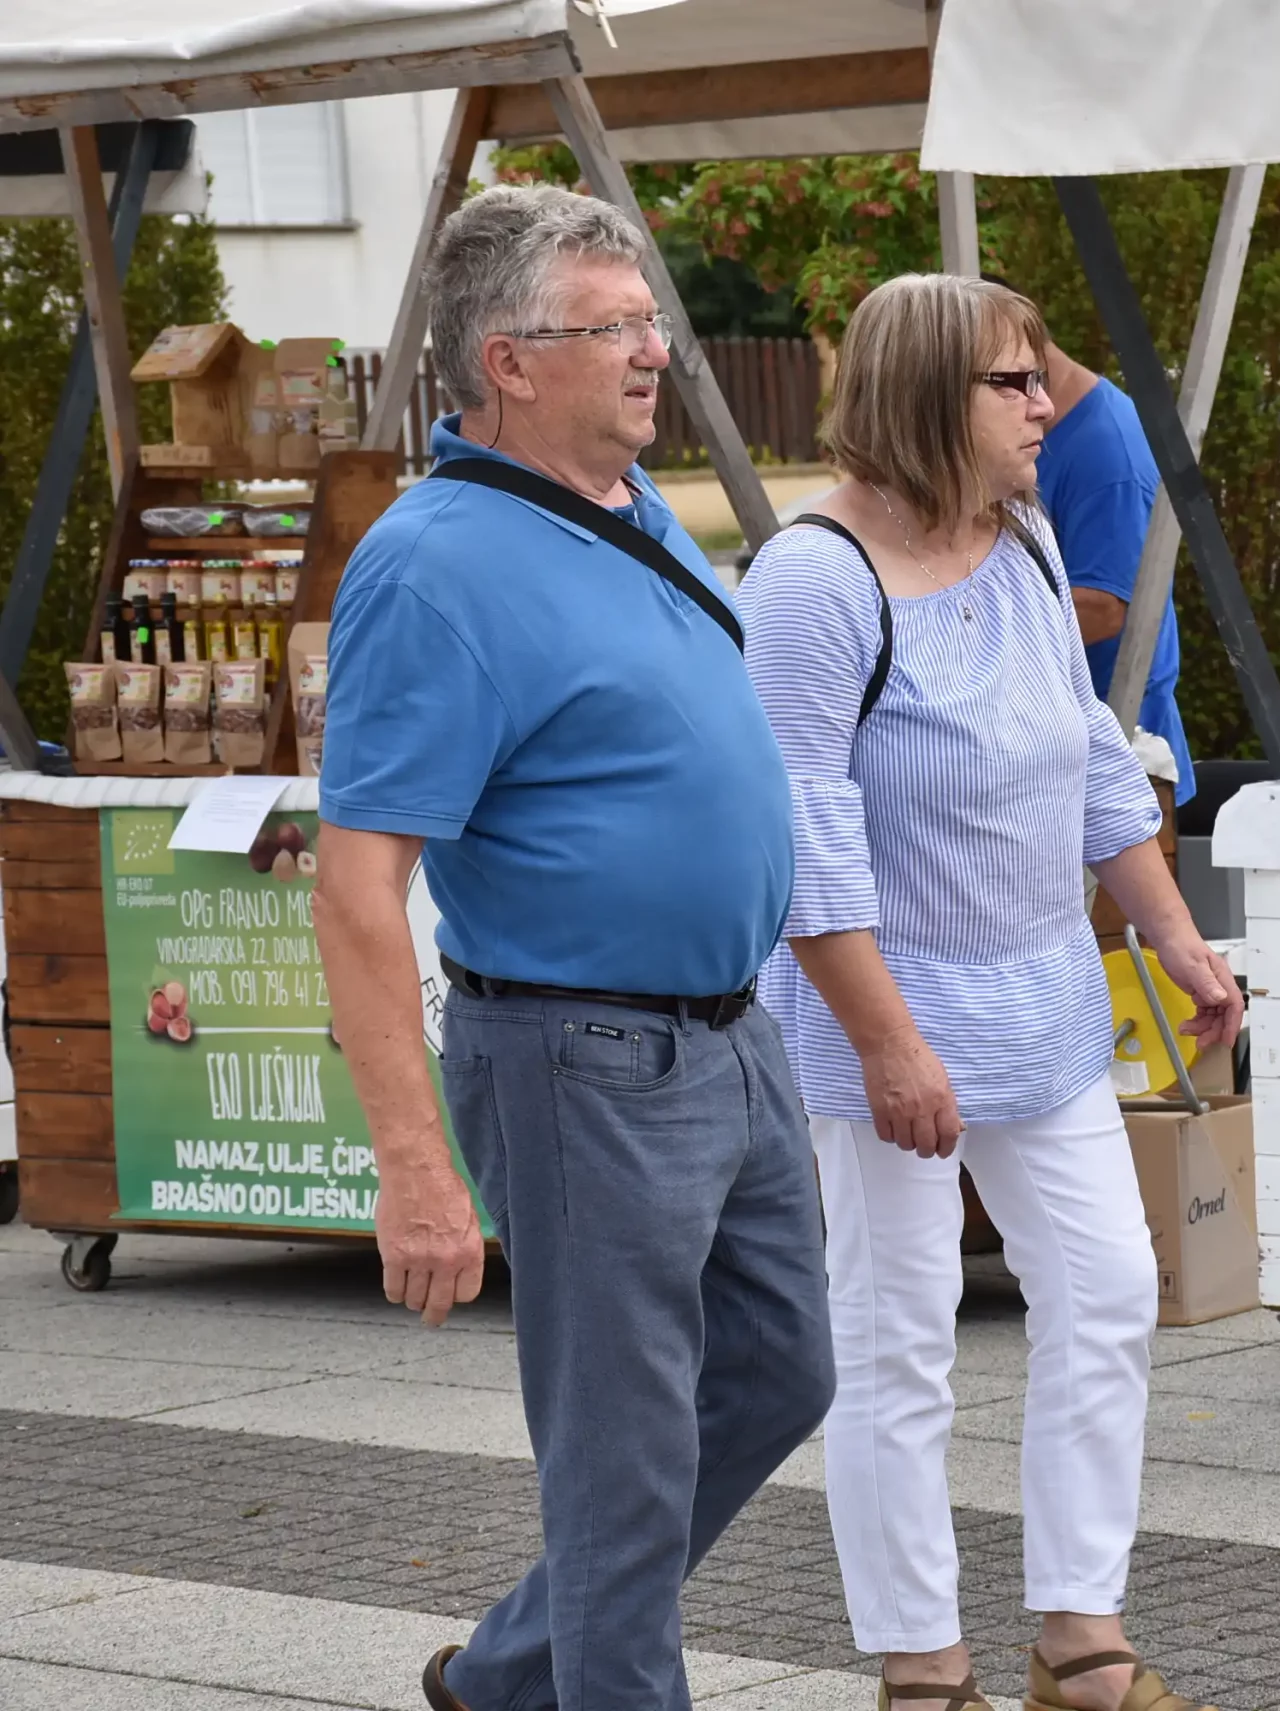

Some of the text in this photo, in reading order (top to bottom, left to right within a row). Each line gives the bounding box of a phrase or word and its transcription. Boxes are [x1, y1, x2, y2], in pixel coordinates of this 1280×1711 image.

[181, 889, 212, 929] OPG
[219, 888, 280, 929] FRANJO
[156, 935, 246, 965] VINOGRADARSKA
[273, 935, 310, 965] DONJA
[190, 970, 226, 1005] MOB.
[231, 969, 257, 1005] 091
[263, 971, 288, 1006] 796
[315, 972, 330, 1006] 2
[421, 976, 443, 1031] FR
[207, 1046, 326, 1123] EKO LJEŠNJAK
[175, 1140, 264, 1177] NAMAZ,
[267, 1143, 330, 1179] ULJE,
[152, 1174, 247, 1214] BRAŠNO
[250, 1184, 281, 1216] OD
[1188, 1188, 1226, 1225] Ornel
